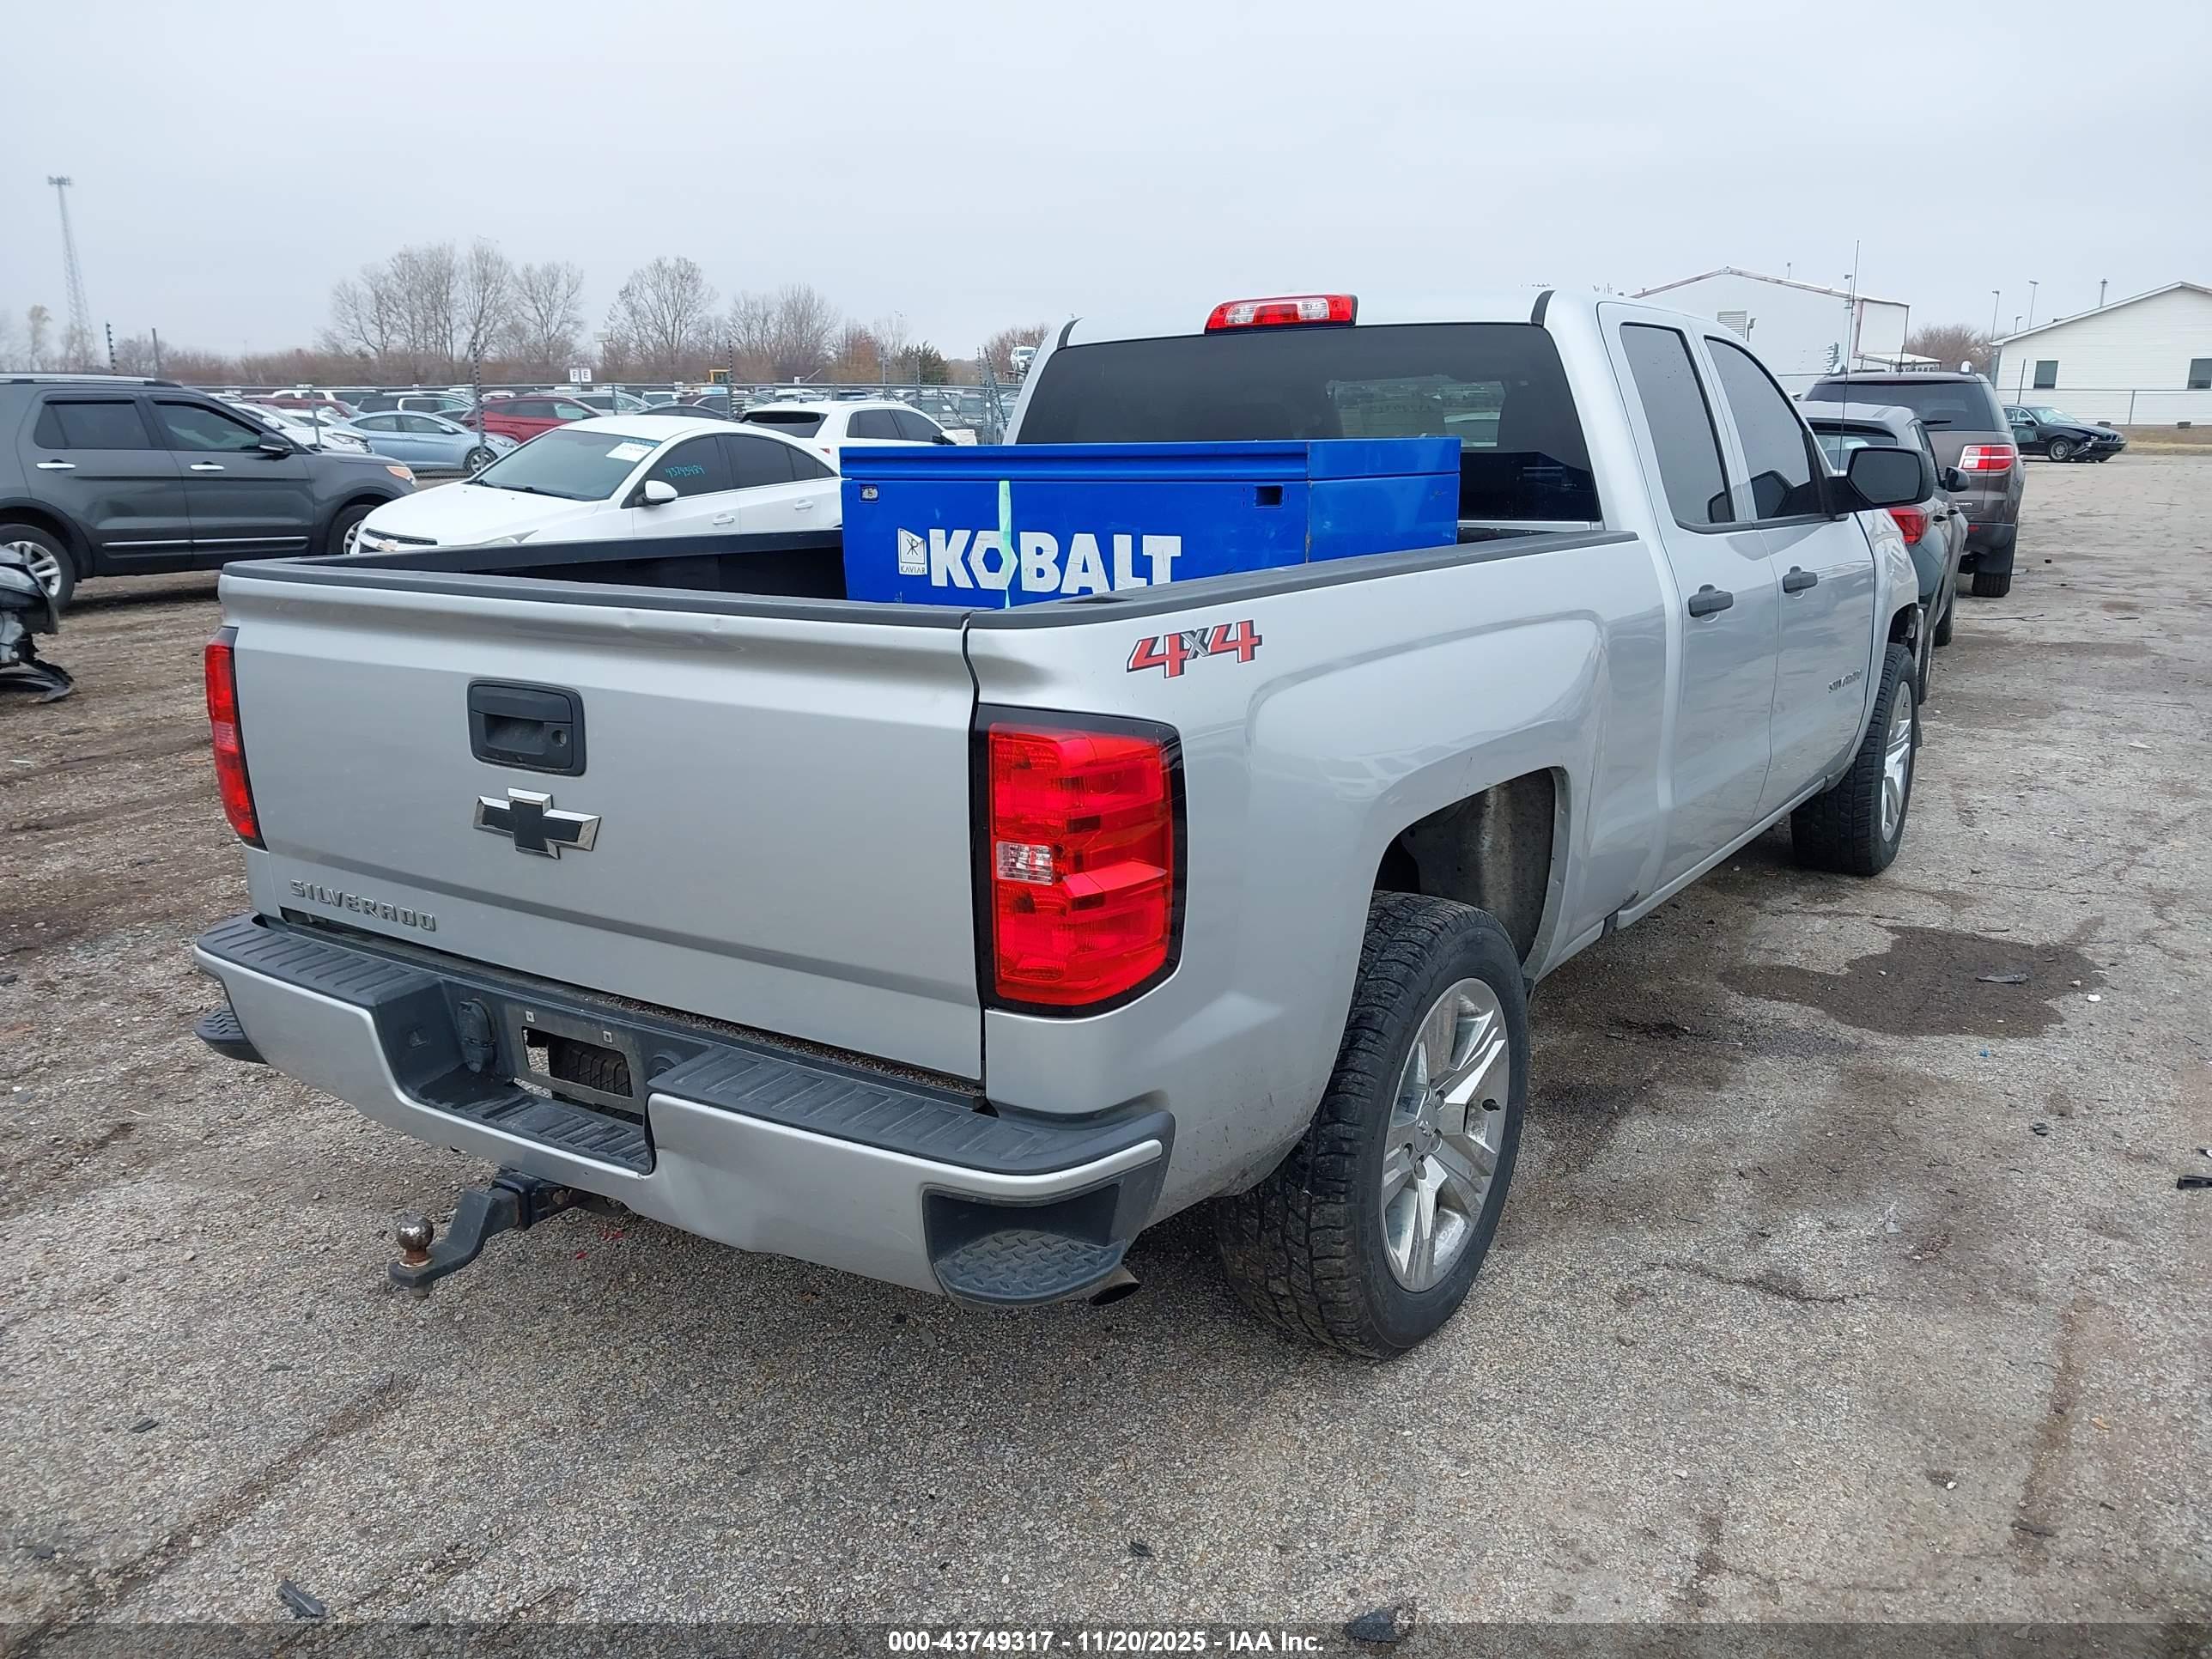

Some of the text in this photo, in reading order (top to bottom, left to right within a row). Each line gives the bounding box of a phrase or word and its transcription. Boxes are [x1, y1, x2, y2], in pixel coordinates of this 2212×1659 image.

[900, 566, 926, 574] KAVIAR
[929, 528, 1182, 595] KOBALT
[289, 878, 436, 933] SILVERADO
